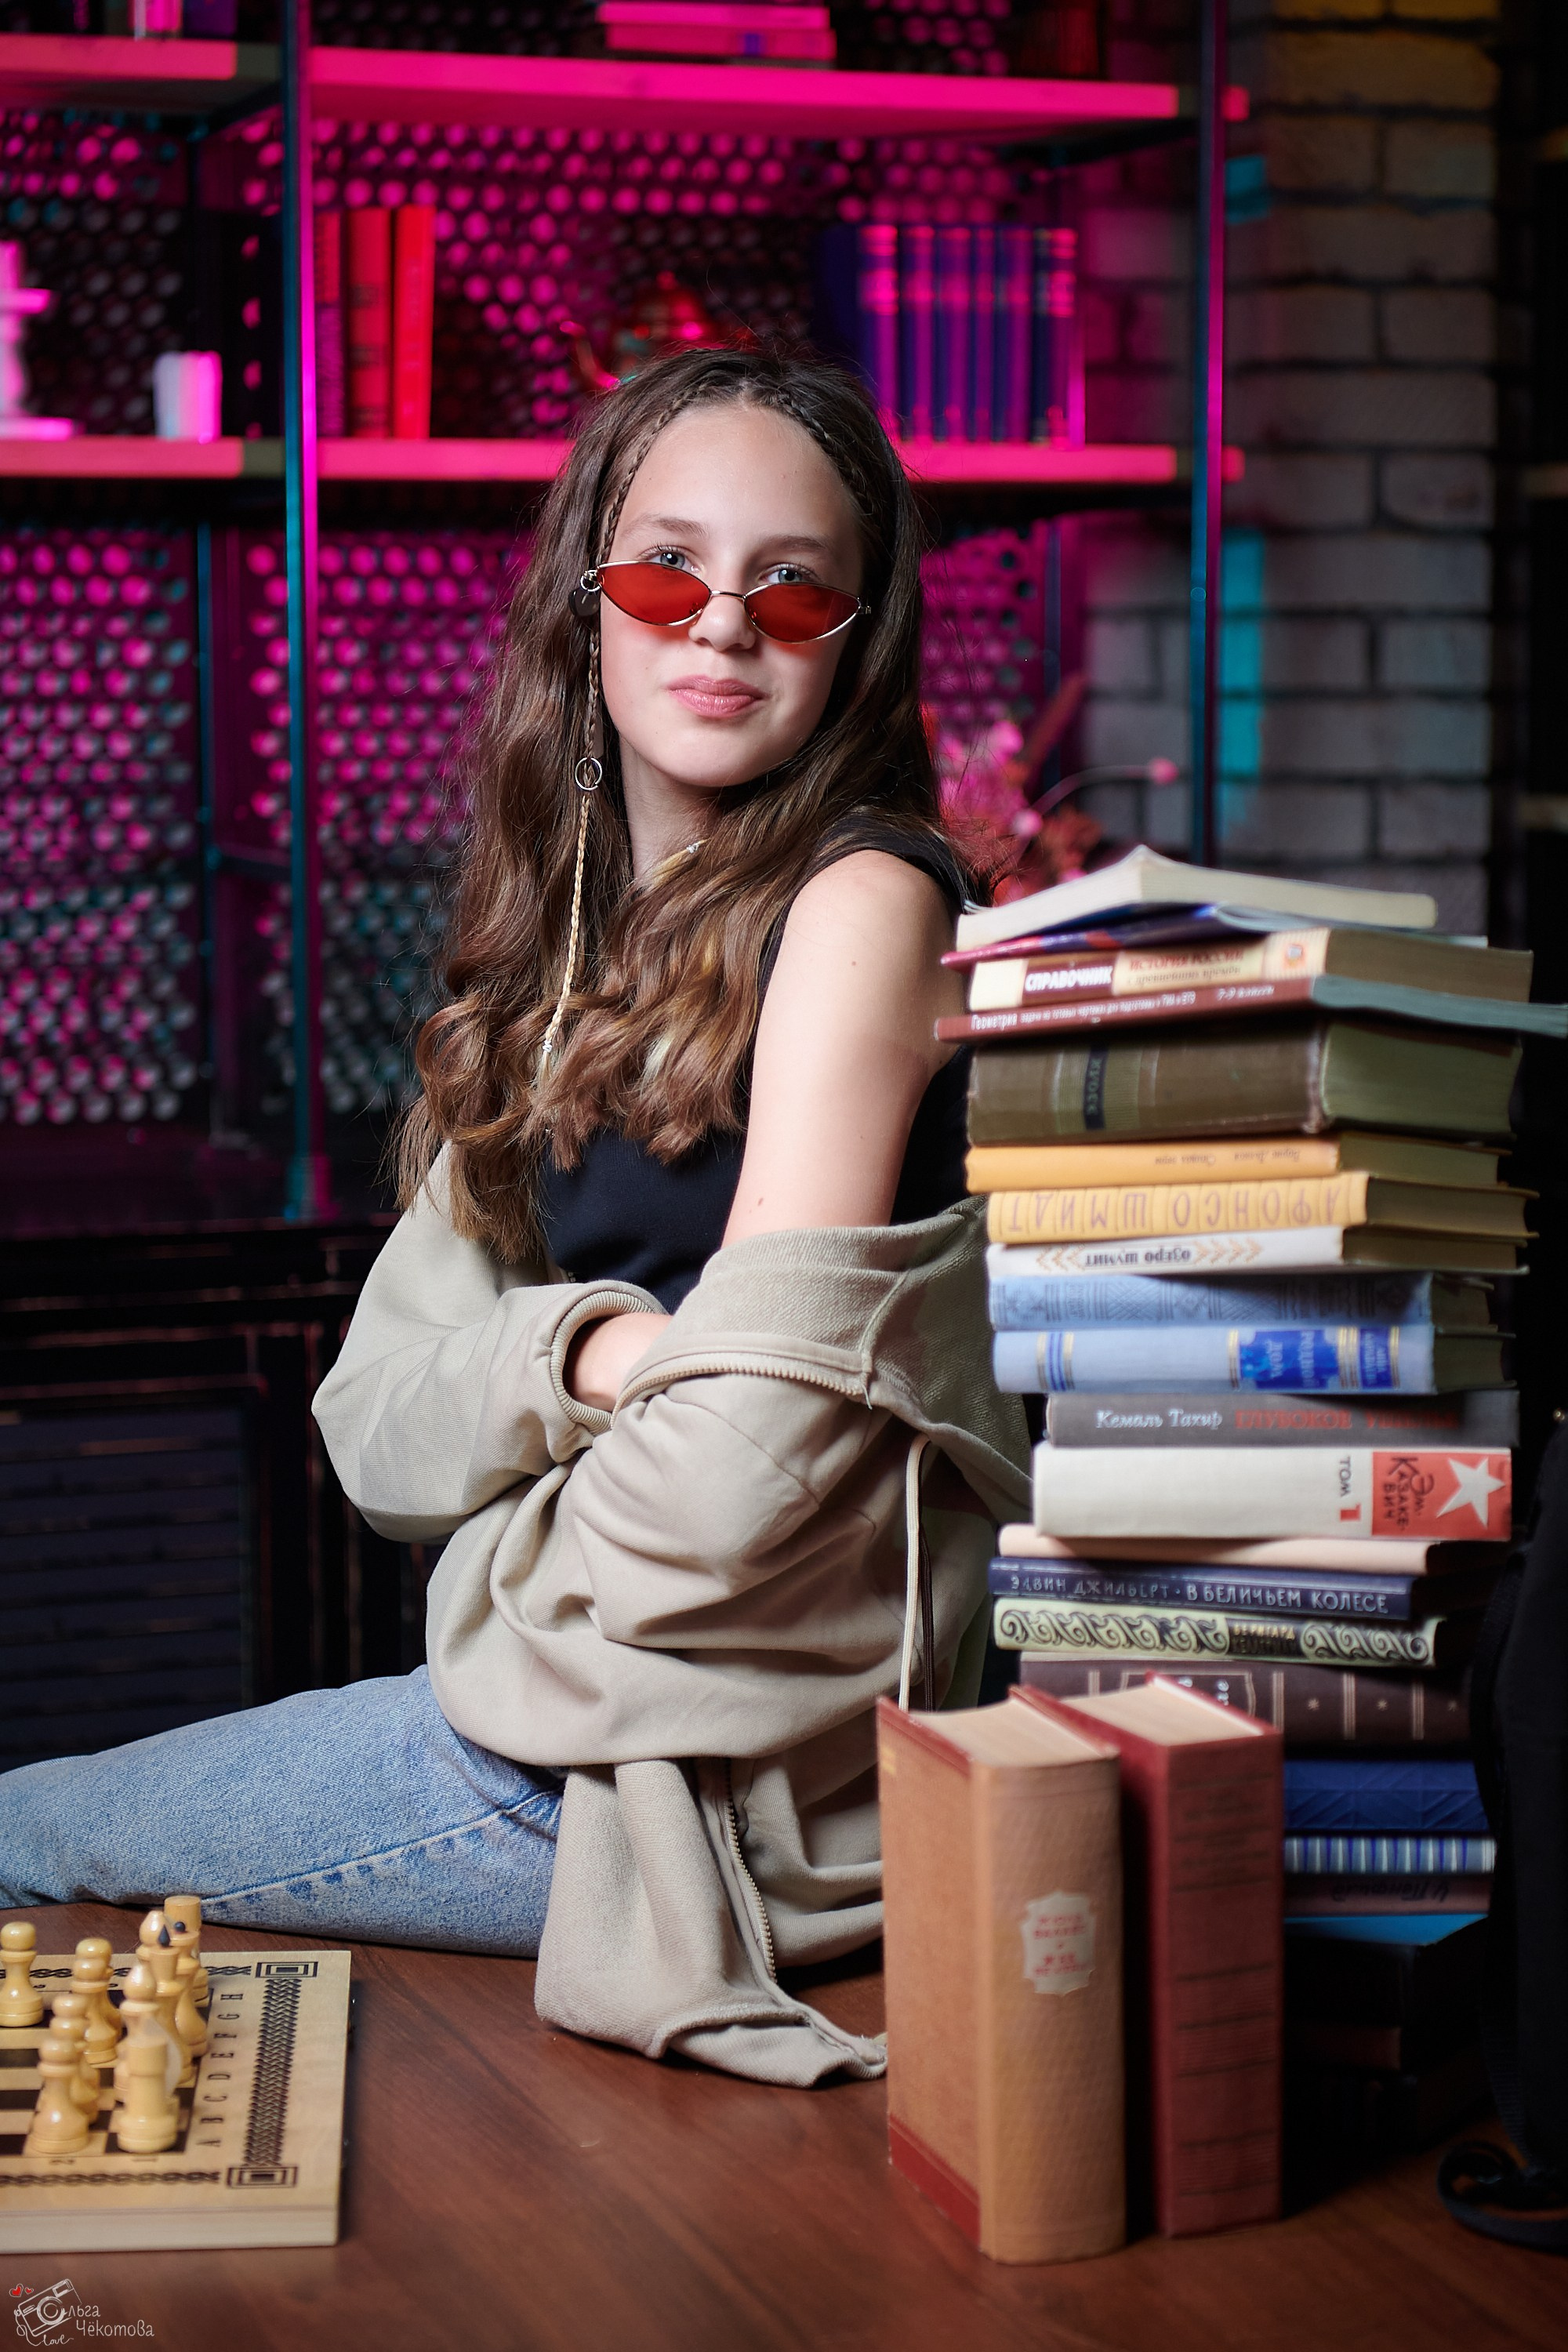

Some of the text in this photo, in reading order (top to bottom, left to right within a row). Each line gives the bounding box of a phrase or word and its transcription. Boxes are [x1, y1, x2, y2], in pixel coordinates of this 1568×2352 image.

[1024, 966, 1113, 992] СПРАВОЧНИК
[971, 1014, 1018, 1030] Геометрия
[1007, 1186, 1341, 1232] АФОНСО ШМИДТ
[1096, 1408, 1223, 1430] Кемаль Тахир
[1339, 1457, 1351, 1497] ТОМ
[1340, 1503, 1361, 1521] 1
[1011, 1575, 1066, 1592] ЭДВИН
[1186, 1584, 1199, 1602] В
[1203, 1584, 1301, 1609] БЕЛИЧЬЕМ
[1312, 1591, 1388, 1614] КОЛЕСЕ
